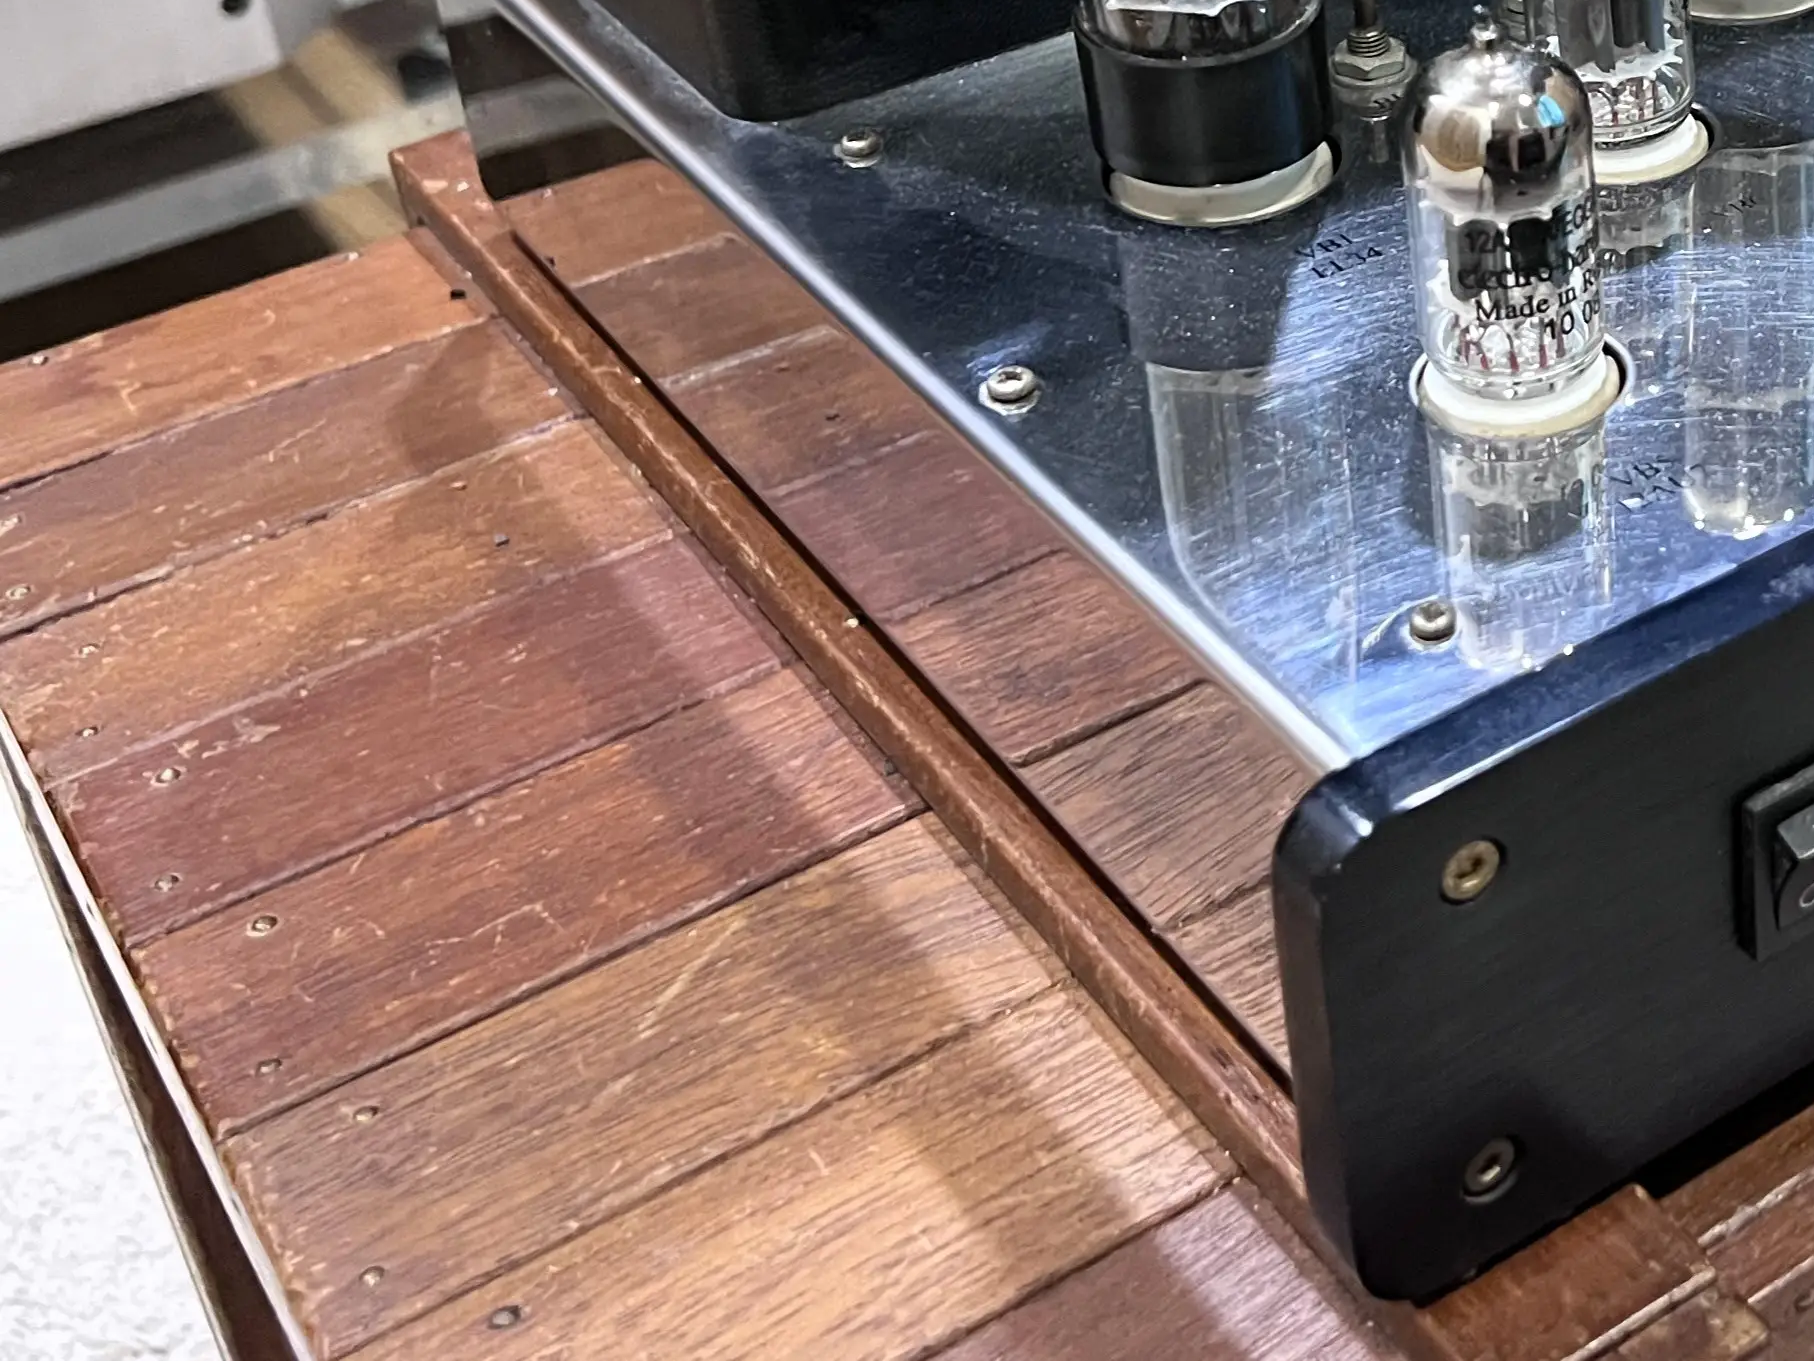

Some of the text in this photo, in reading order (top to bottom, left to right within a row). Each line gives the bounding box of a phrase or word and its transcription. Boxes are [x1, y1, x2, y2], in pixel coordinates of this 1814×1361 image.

[1294, 234, 1353, 259] VB1
[1475, 295, 1551, 322] Made
[1558, 286, 1578, 308] in
